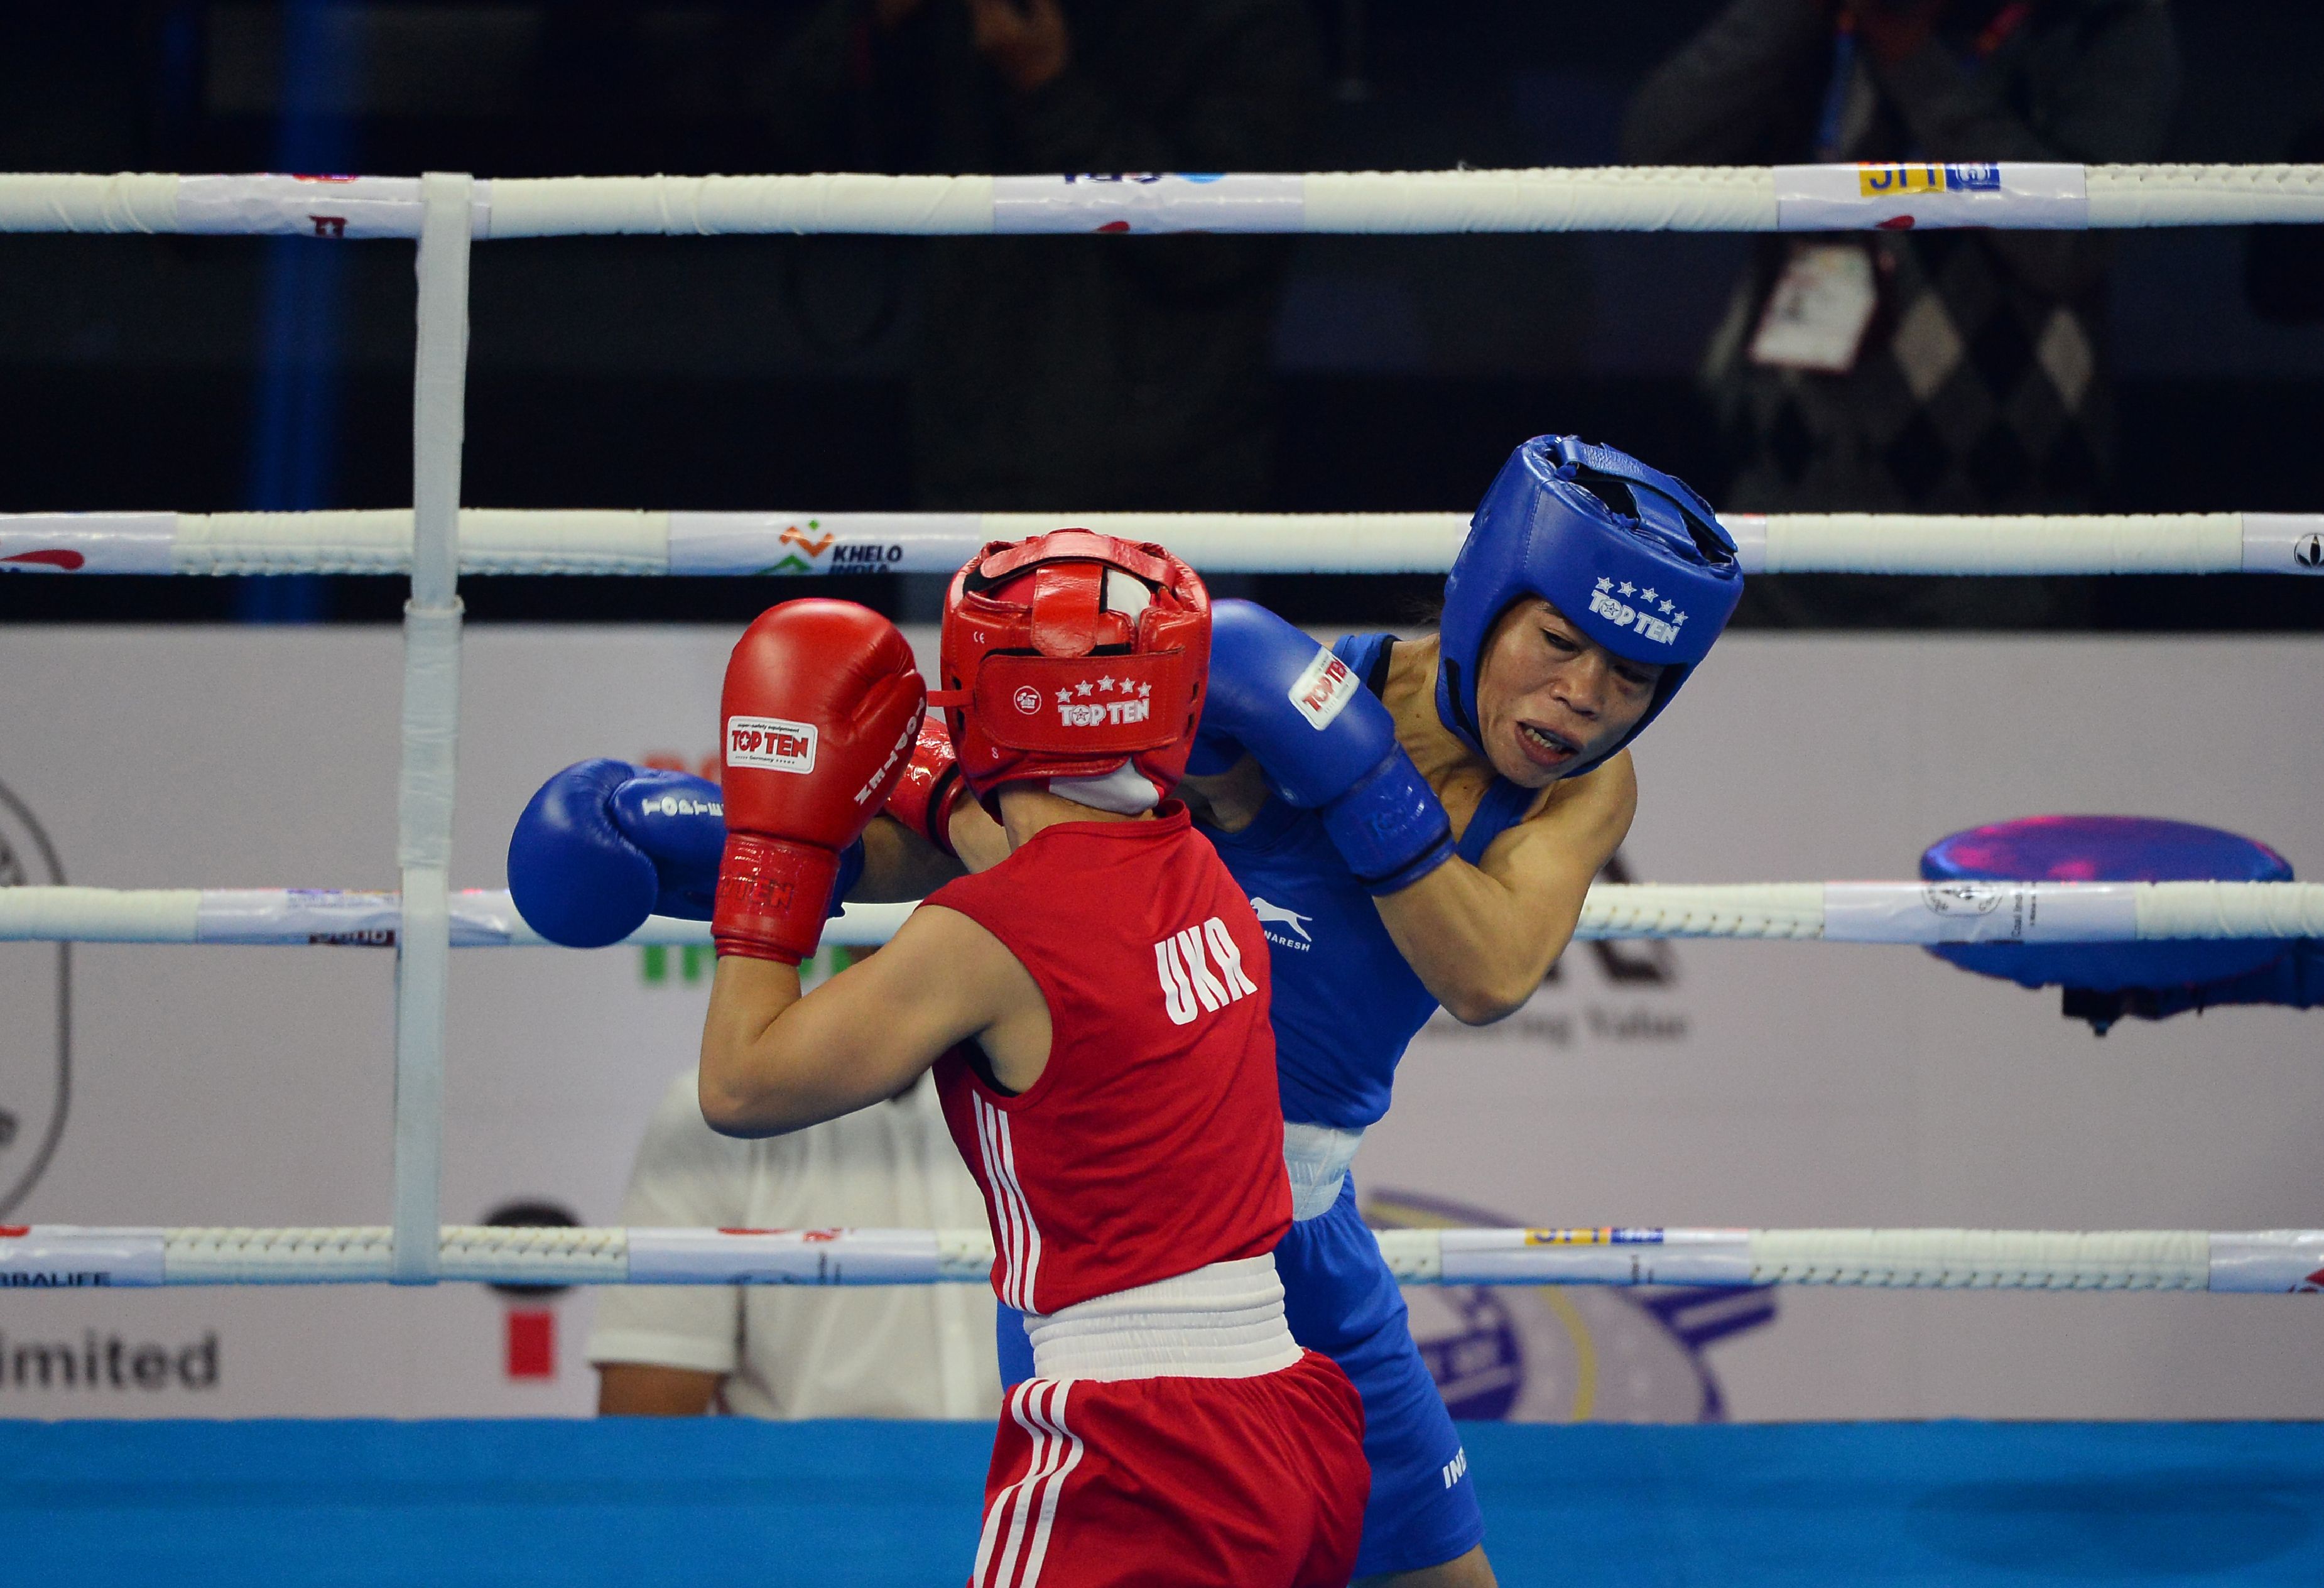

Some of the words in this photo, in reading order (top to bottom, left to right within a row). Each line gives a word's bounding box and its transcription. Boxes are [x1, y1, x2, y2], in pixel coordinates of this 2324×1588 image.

[833, 545, 902, 562] KHELO
[1589, 589, 1636, 626] TOP
[1634, 611, 1680, 646] TEN
[1058, 704, 1106, 726] TOP
[1107, 698, 1149, 724] TEN
[732, 731, 762, 752] TOP
[764, 732, 808, 758] TEN
[1154, 916, 1258, 1025] UKR
